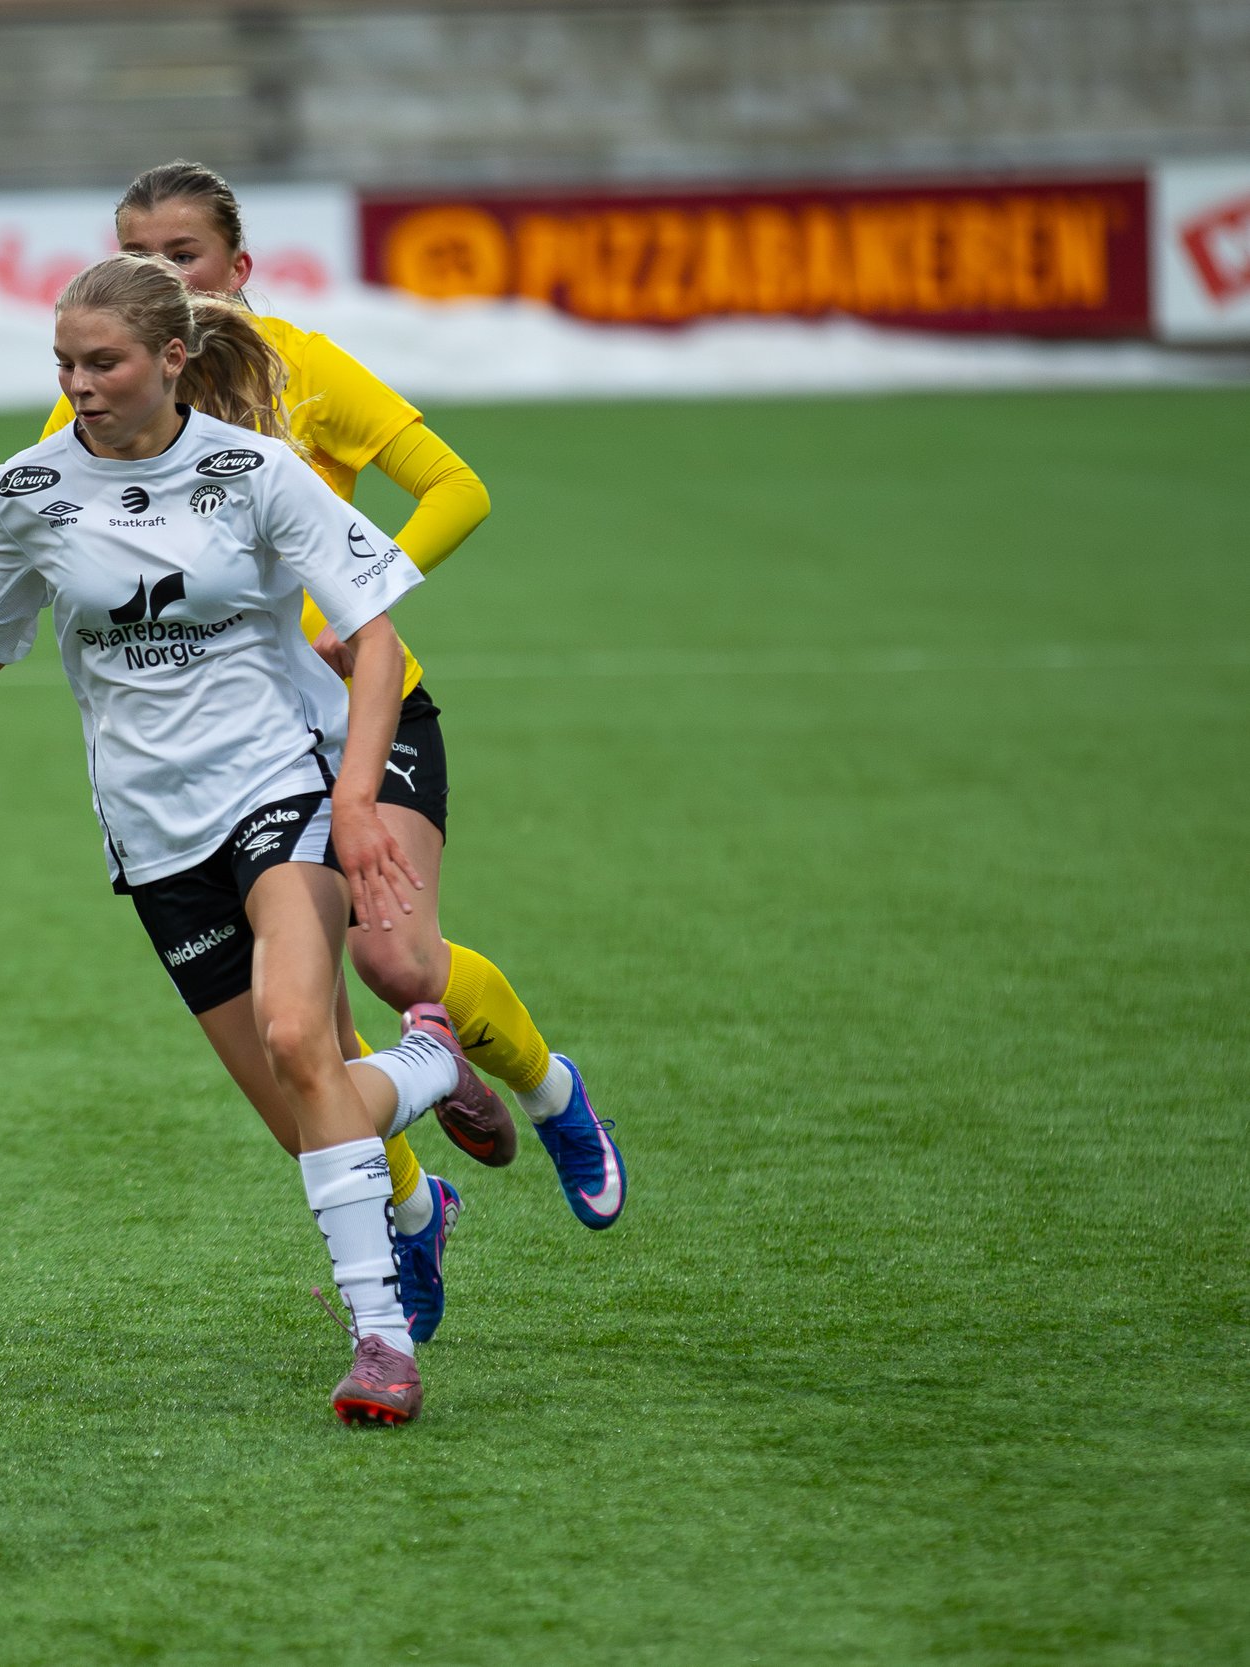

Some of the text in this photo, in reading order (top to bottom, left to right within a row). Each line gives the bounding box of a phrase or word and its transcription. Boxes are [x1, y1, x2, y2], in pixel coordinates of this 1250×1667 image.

[199, 452, 258, 474] Lerum
[0, 469, 54, 493] Lerum
[191, 486, 226, 505] SOGNDAL
[109, 516, 167, 528] Statkraft
[124, 642, 206, 670] Norge
[251, 842, 280, 861] umbro
[164, 924, 236, 967] Veidekke
